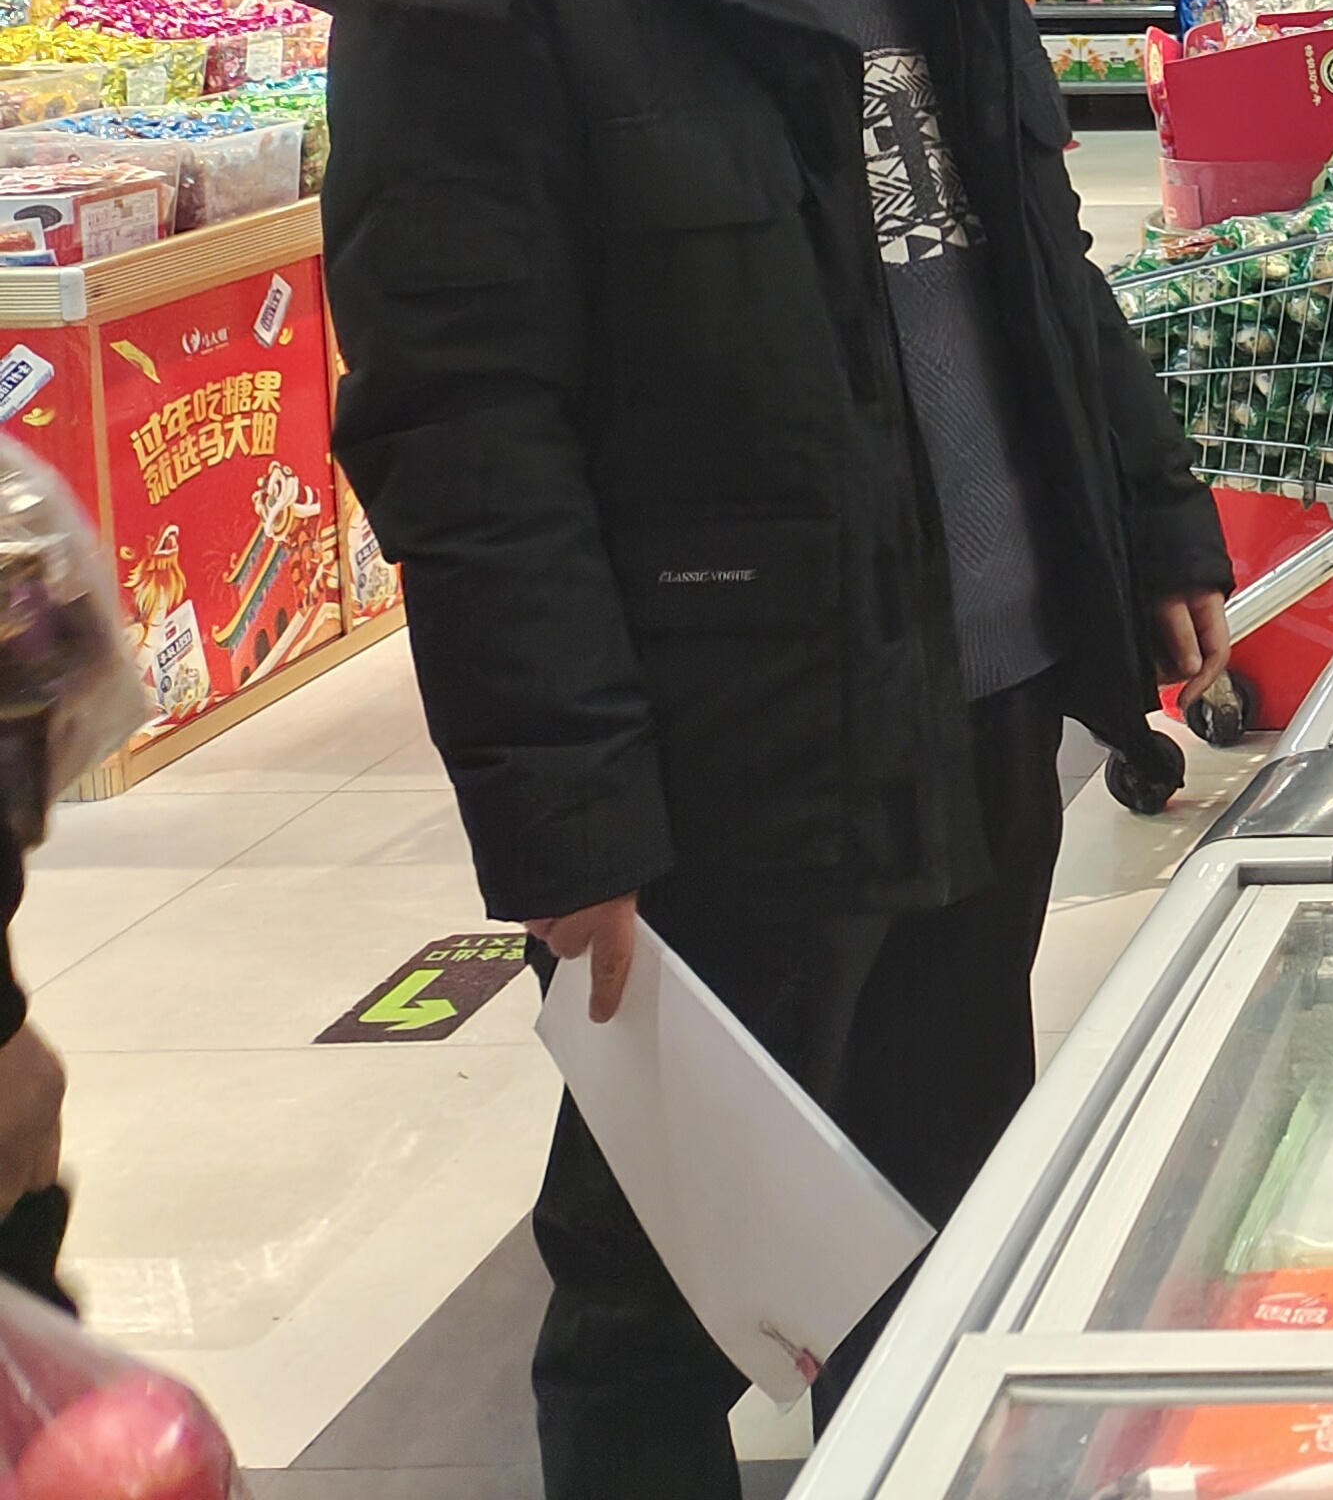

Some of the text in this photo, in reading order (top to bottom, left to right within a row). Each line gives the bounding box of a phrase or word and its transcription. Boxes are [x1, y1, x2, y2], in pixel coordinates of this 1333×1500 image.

[130, 370, 283, 471] 过年吃糖果
[143, 411, 278, 506] 就选马大姐
